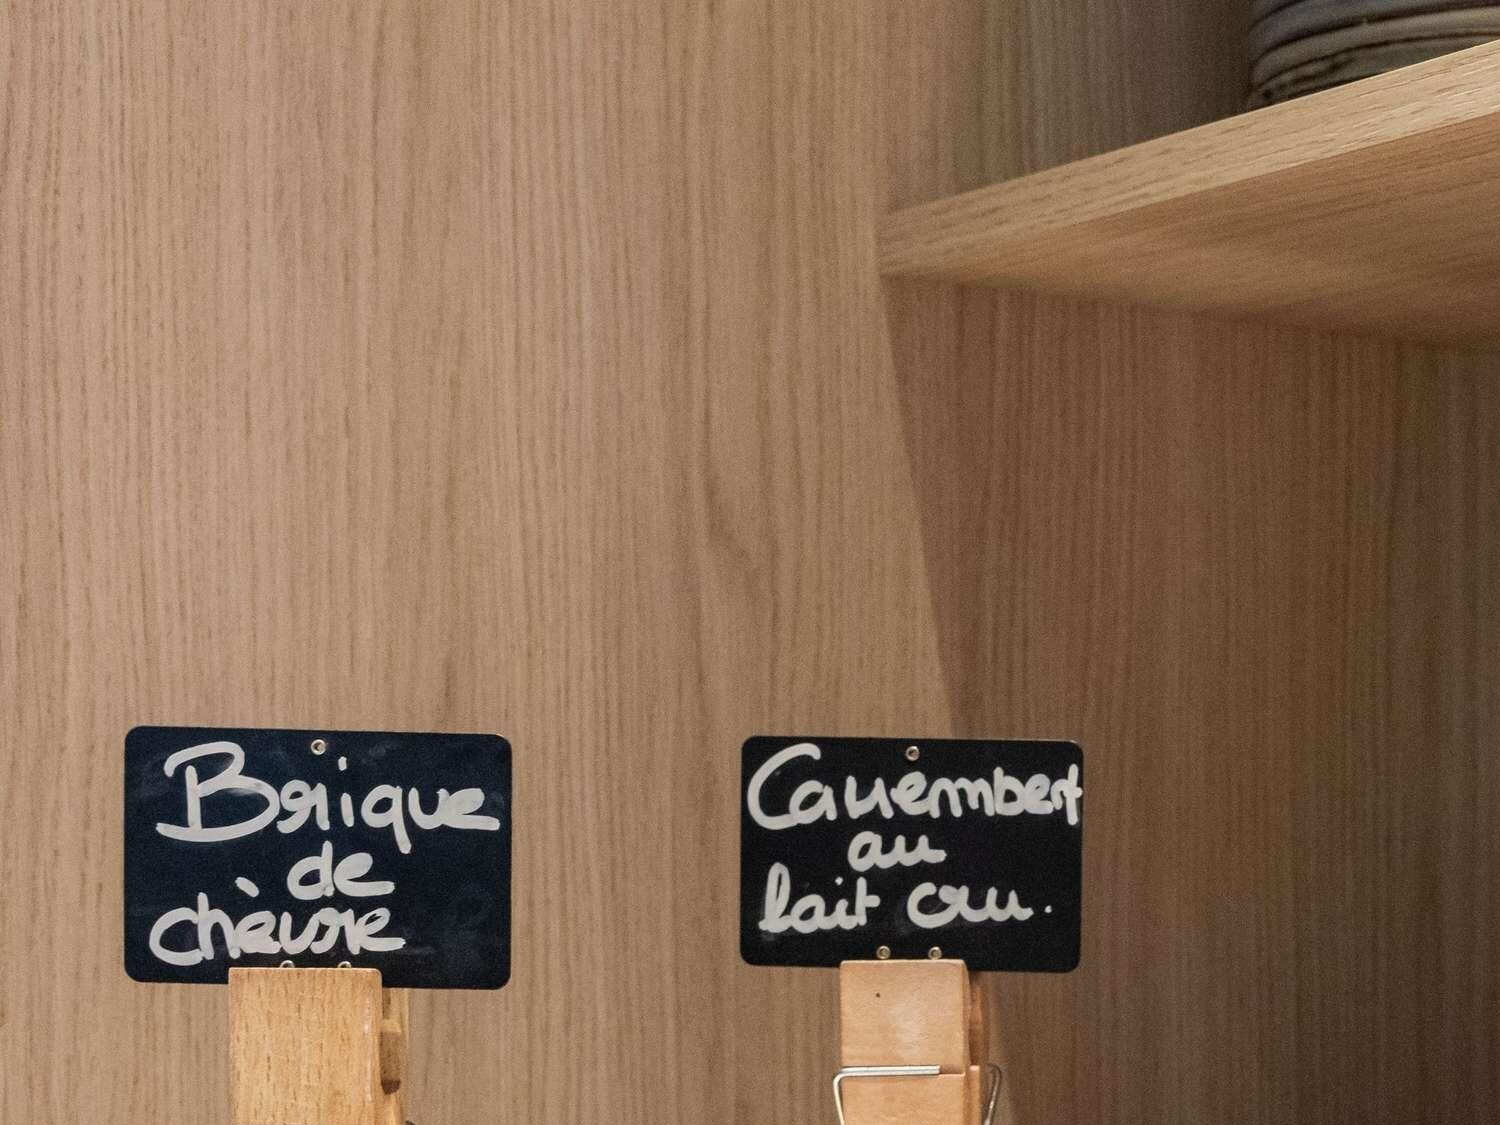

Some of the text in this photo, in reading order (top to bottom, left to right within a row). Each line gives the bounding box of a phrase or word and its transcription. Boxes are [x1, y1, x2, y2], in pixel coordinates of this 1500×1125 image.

[287, 841, 395, 900] de
[848, 831, 947, 872] au
[149, 877, 406, 966] chèvre
[758, 862, 880, 933] lait
